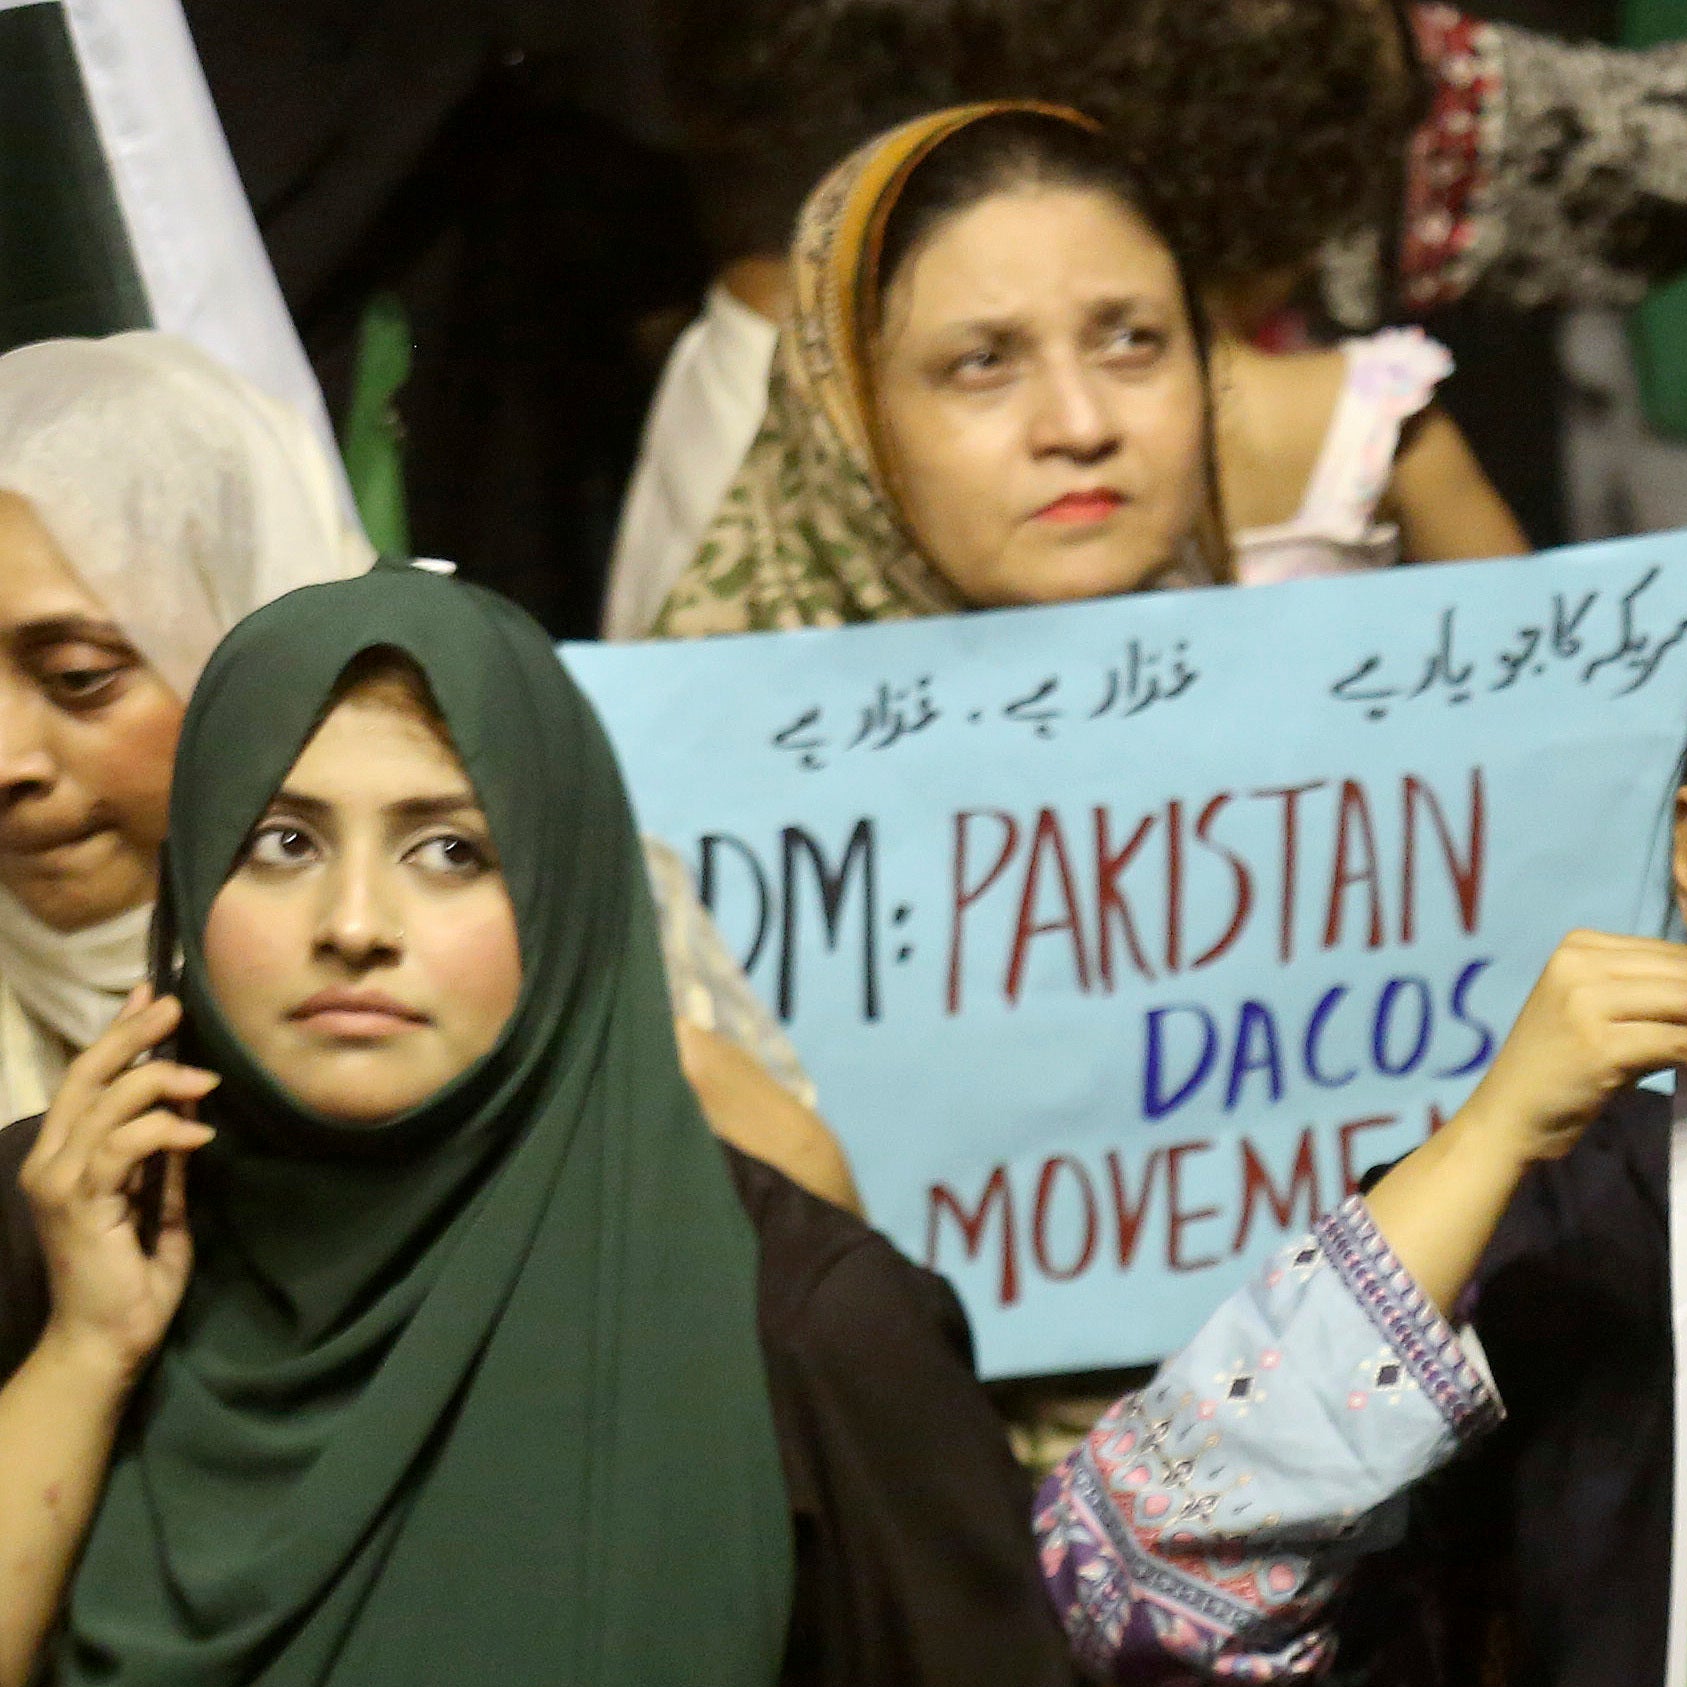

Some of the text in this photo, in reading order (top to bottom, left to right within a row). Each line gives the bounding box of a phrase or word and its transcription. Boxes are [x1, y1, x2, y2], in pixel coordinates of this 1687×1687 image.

[697, 764, 1487, 1023] DM: PAKISTAN
[1142, 956, 1497, 1121] DACOS
